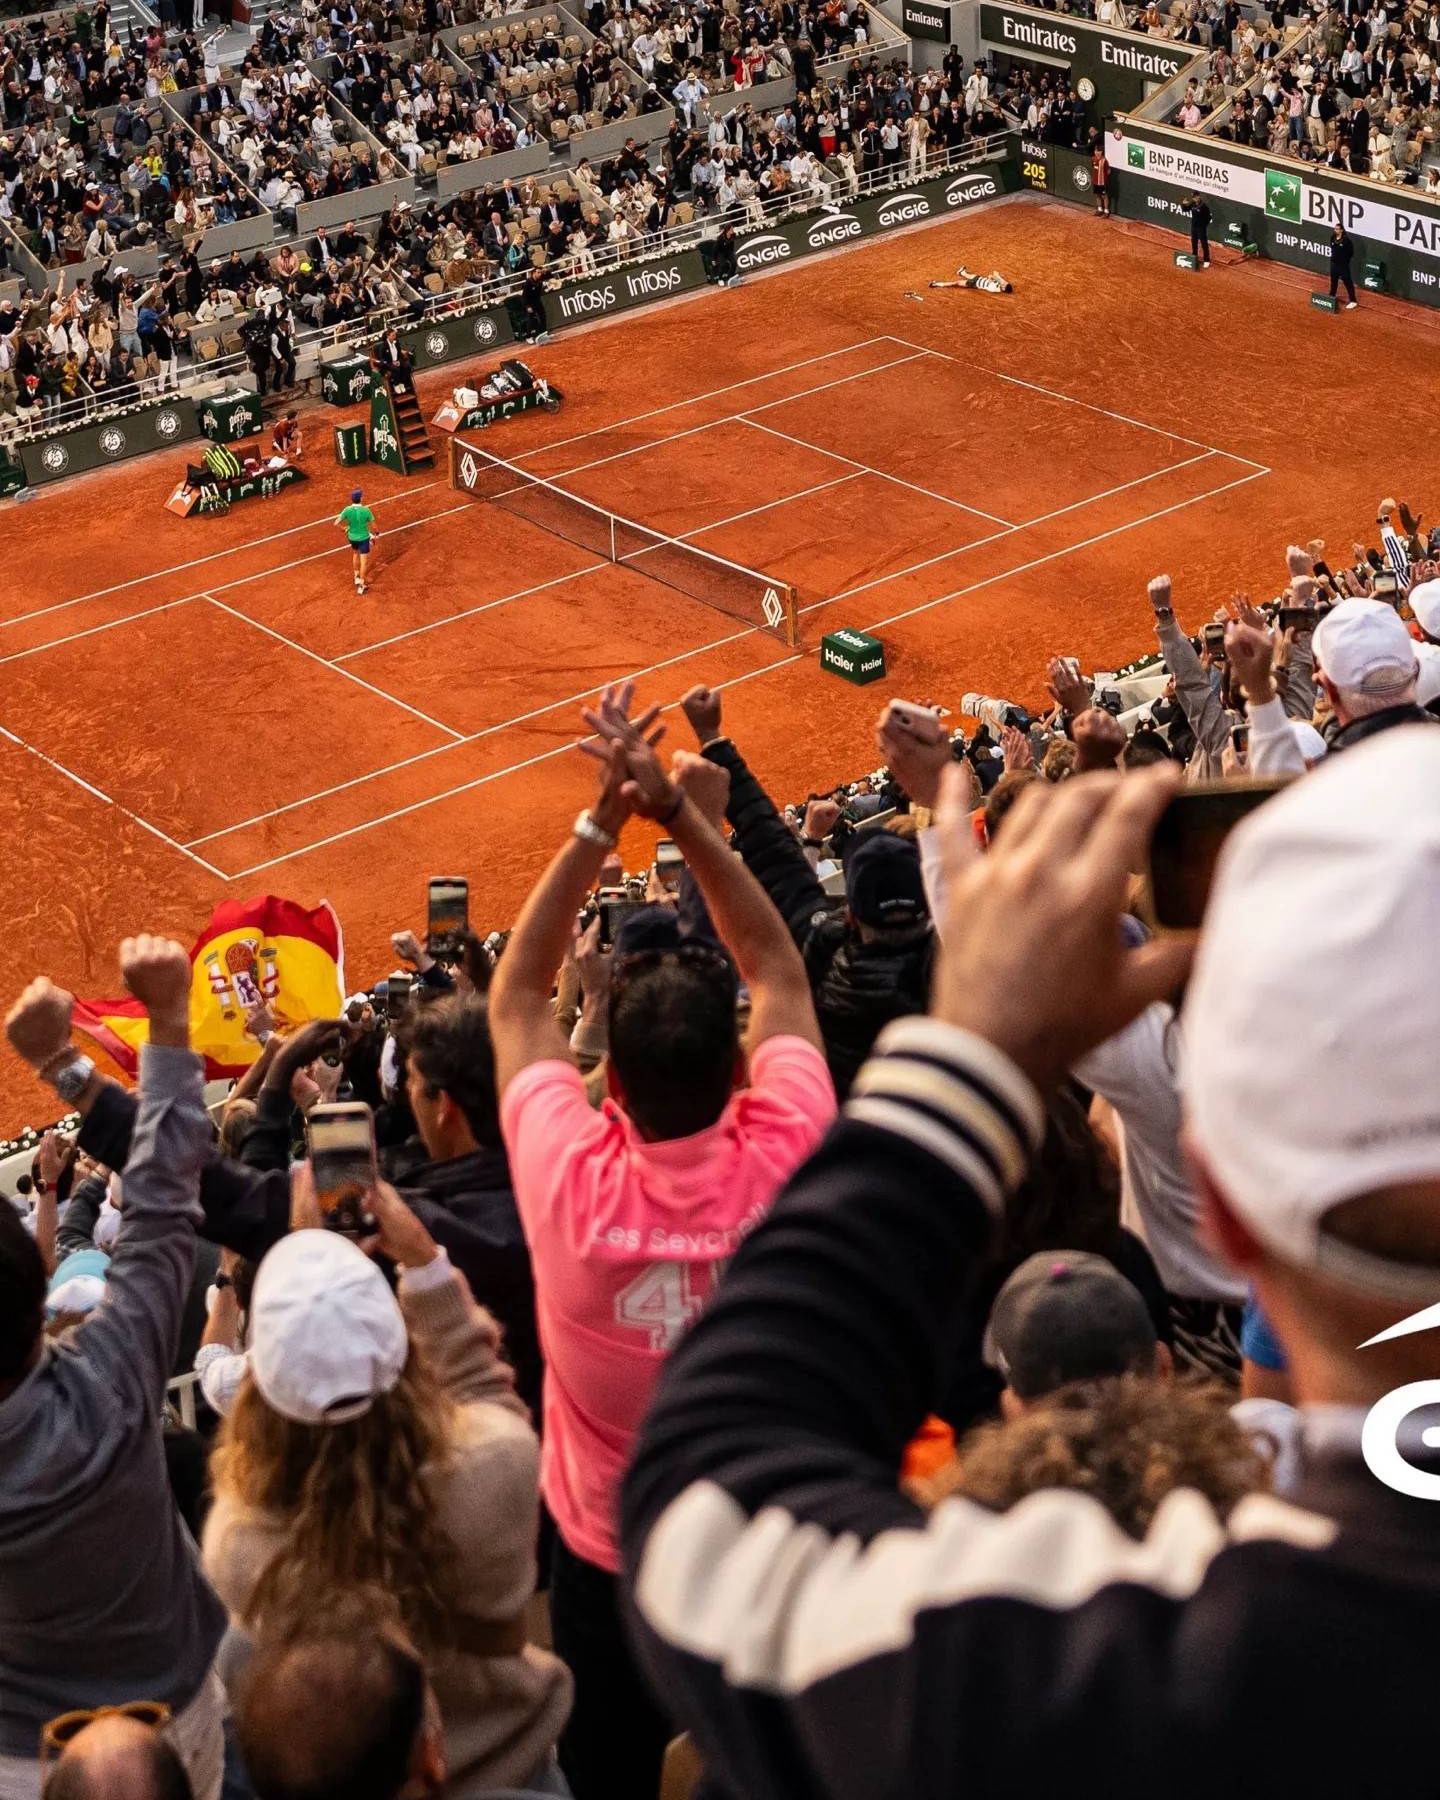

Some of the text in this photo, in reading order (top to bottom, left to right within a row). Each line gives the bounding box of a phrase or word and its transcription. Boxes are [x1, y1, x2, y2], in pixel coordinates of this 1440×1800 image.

[905, 8, 943, 29] Emirates
[1002, 16, 1077, 53] Emirates
[1100, 40, 1179, 78] Emirates
[1023, 161, 1047, 180] 205
[1149, 150, 1229, 184] BNP PARIBAS
[1147, 195, 1169, 211] BNP
[1308, 189, 1365, 229] BNP
[1275, 231, 1333, 258] BNP PARIB
[626, 266, 682, 298] Infosys
[1411, 270, 1437, 288] BNP
[559, 285, 616, 317] Infosys
[834, 630, 869, 648] Haier
[825, 648, 854, 673] Haier
[860, 657, 883, 673] Haier
